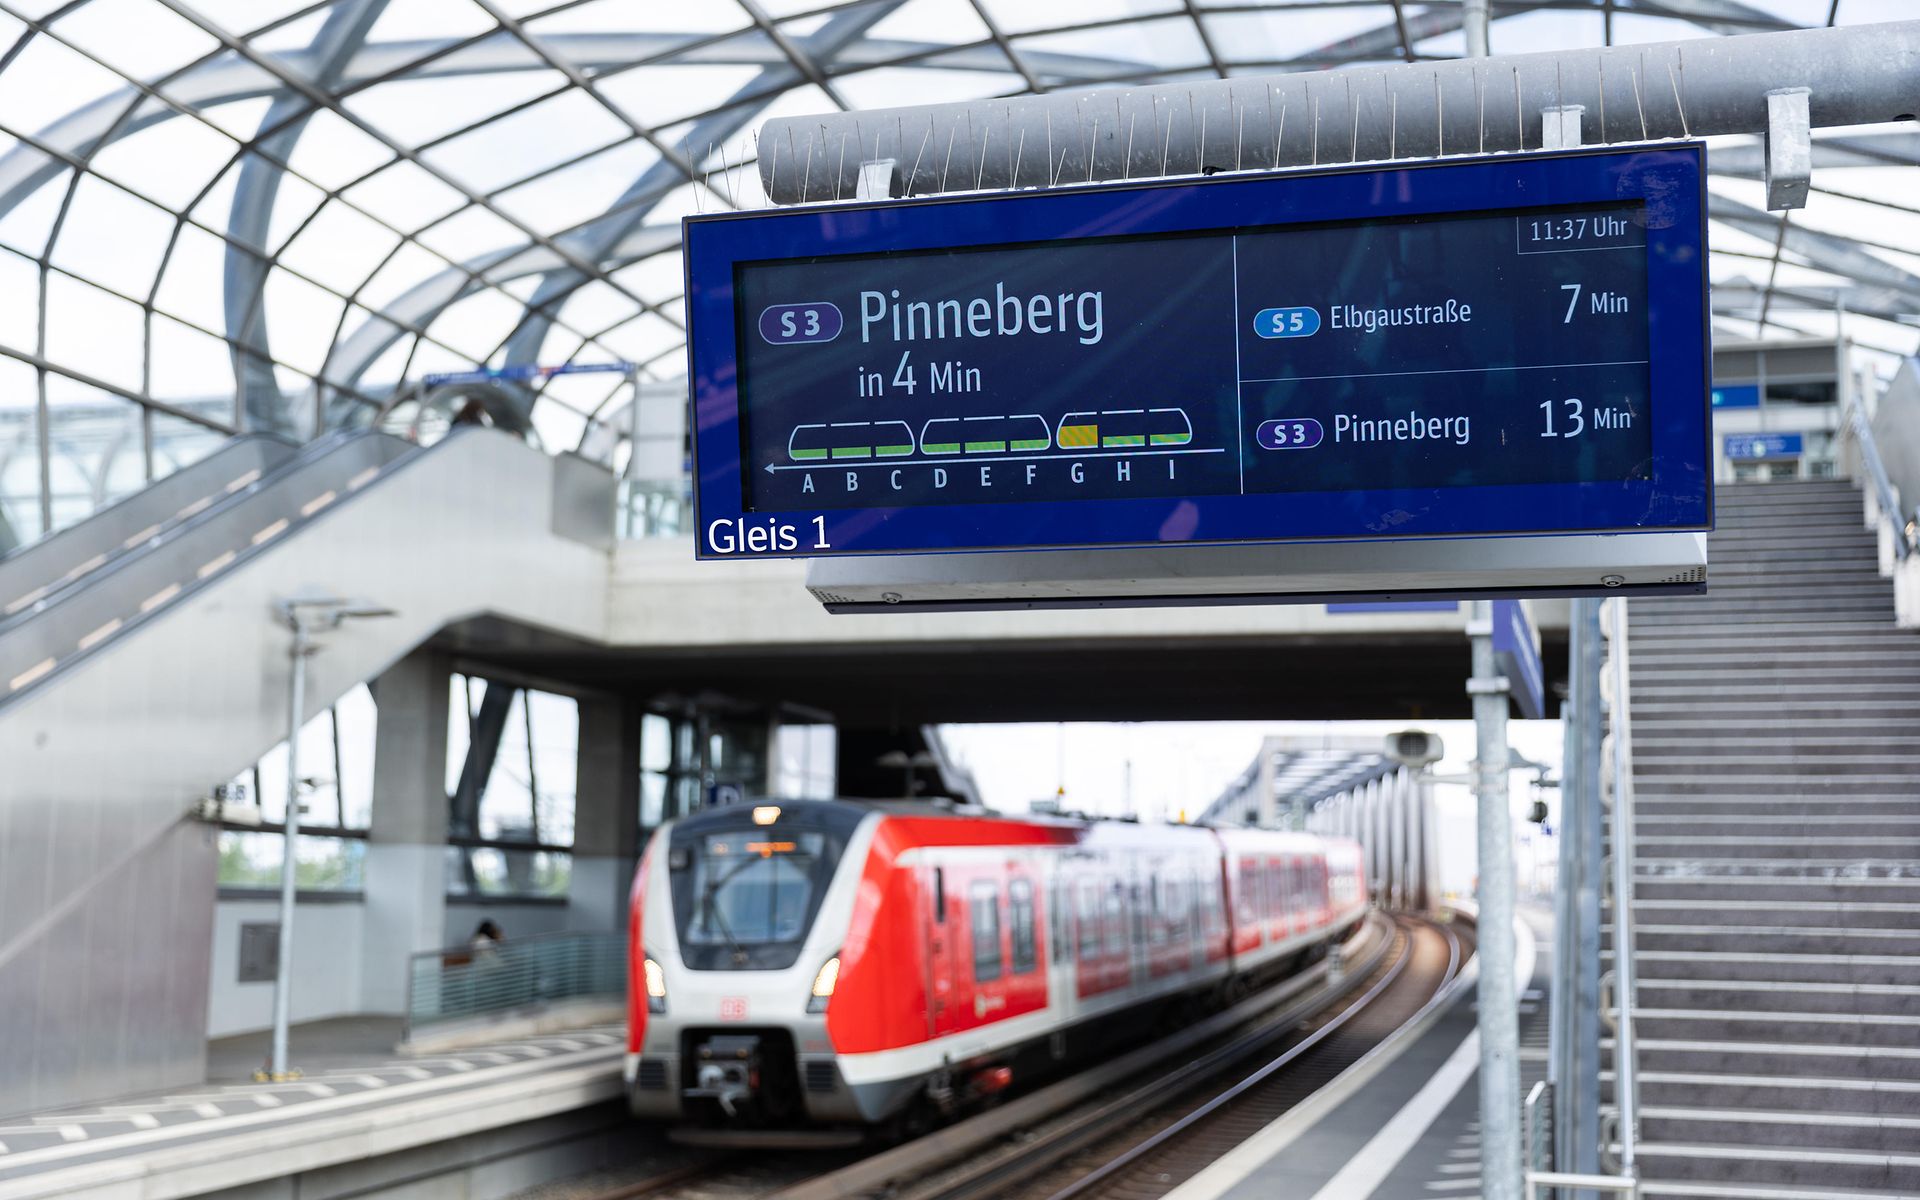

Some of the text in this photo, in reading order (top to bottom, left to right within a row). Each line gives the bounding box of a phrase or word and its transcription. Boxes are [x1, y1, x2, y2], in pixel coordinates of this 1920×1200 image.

[1531, 216, 1628, 241] 11:37 Uhr
[860, 281, 1103, 345] Pinneberg
[1331, 298, 1471, 333] Elbgaustraße
[1560, 283, 1582, 324] 7
[1591, 291, 1628, 315] Min
[858, 350, 982, 398] in 4 Min
[1335, 410, 1470, 445] Pinneberg
[1539, 398, 1584, 438] 13
[1594, 407, 1631, 430] Min
[802, 473, 815, 493] A
[846, 471, 859, 492] B
[890, 469, 902, 490] C
[934, 468, 947, 488] D
[980, 466, 992, 487] E
[1026, 464, 1037, 485] F
[1070, 462, 1084, 484] G
[1117, 461, 1131, 482] H
[708, 515, 831, 554] Gleis 1
